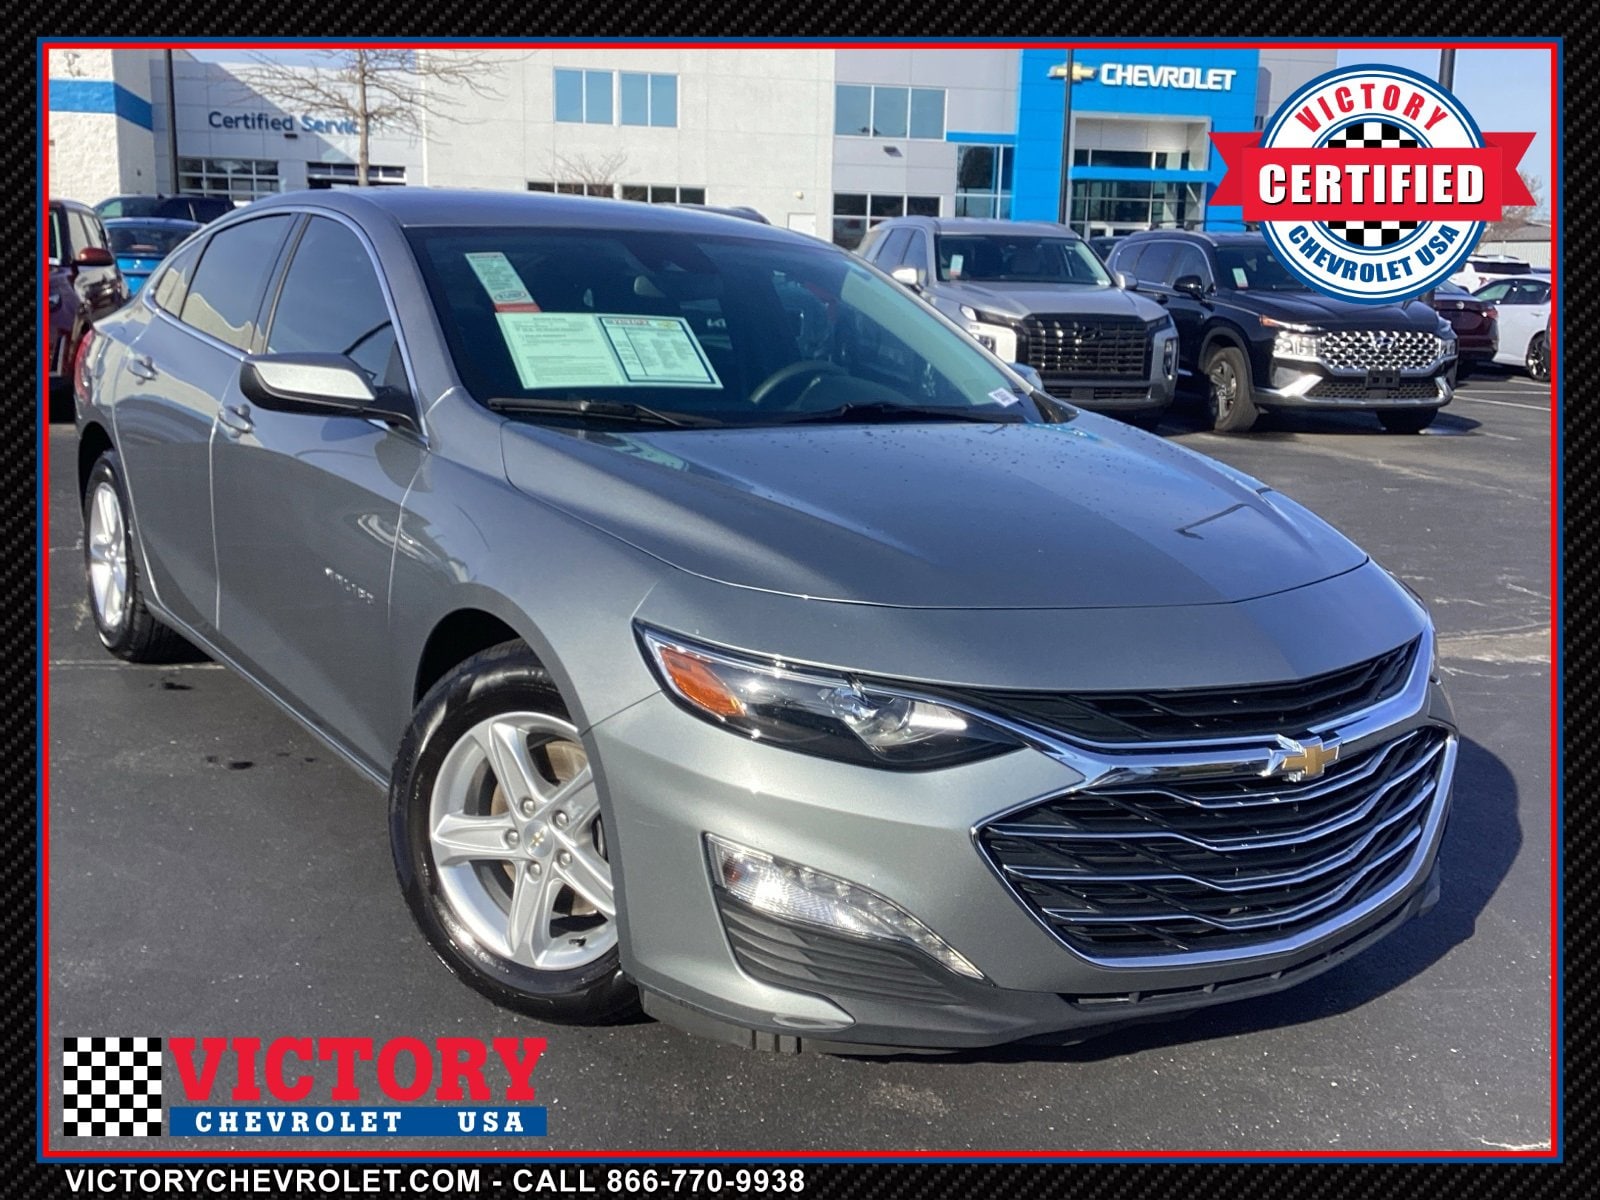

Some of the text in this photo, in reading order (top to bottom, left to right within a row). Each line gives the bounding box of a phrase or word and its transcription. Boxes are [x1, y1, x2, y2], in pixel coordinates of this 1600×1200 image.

[1101, 63, 1236, 91] CHEVROLET
[208, 111, 372, 135] Certified Servic
